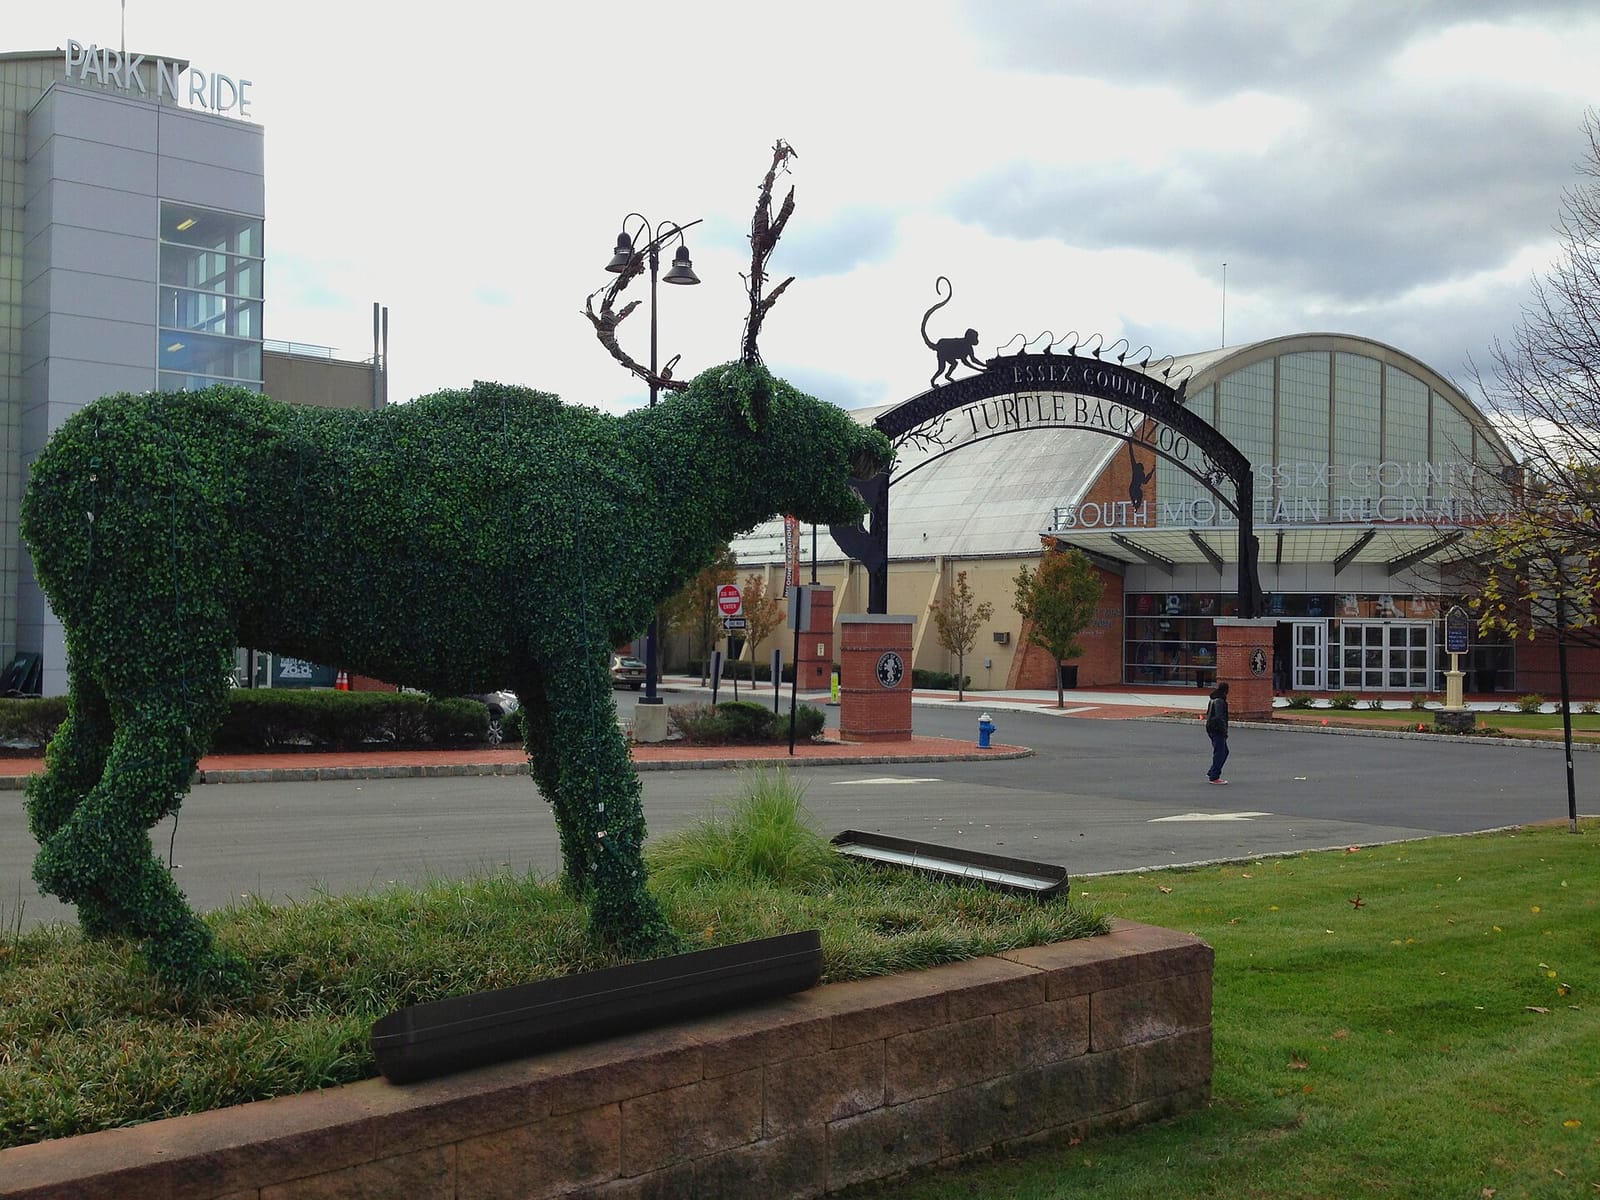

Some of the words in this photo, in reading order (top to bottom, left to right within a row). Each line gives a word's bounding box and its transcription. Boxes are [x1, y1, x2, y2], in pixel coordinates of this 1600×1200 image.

[65, 38, 147, 93] PARK
[156, 58, 179, 100] N
[189, 67, 253, 116] RIDE
[1013, 365, 1073, 383] ESSEX
[1083, 368, 1160, 405] COUNTY
[962, 395, 1067, 434] TURTLE
[1074, 396, 1139, 434] BACK
[1145, 418, 1189, 461] ZOO
[1253, 462, 1329, 489] SSEX
[1349, 461, 1477, 489] COUNTY
[1066, 499, 1148, 529] SOUTH
[1163, 496, 1321, 525] MOUTAIN
